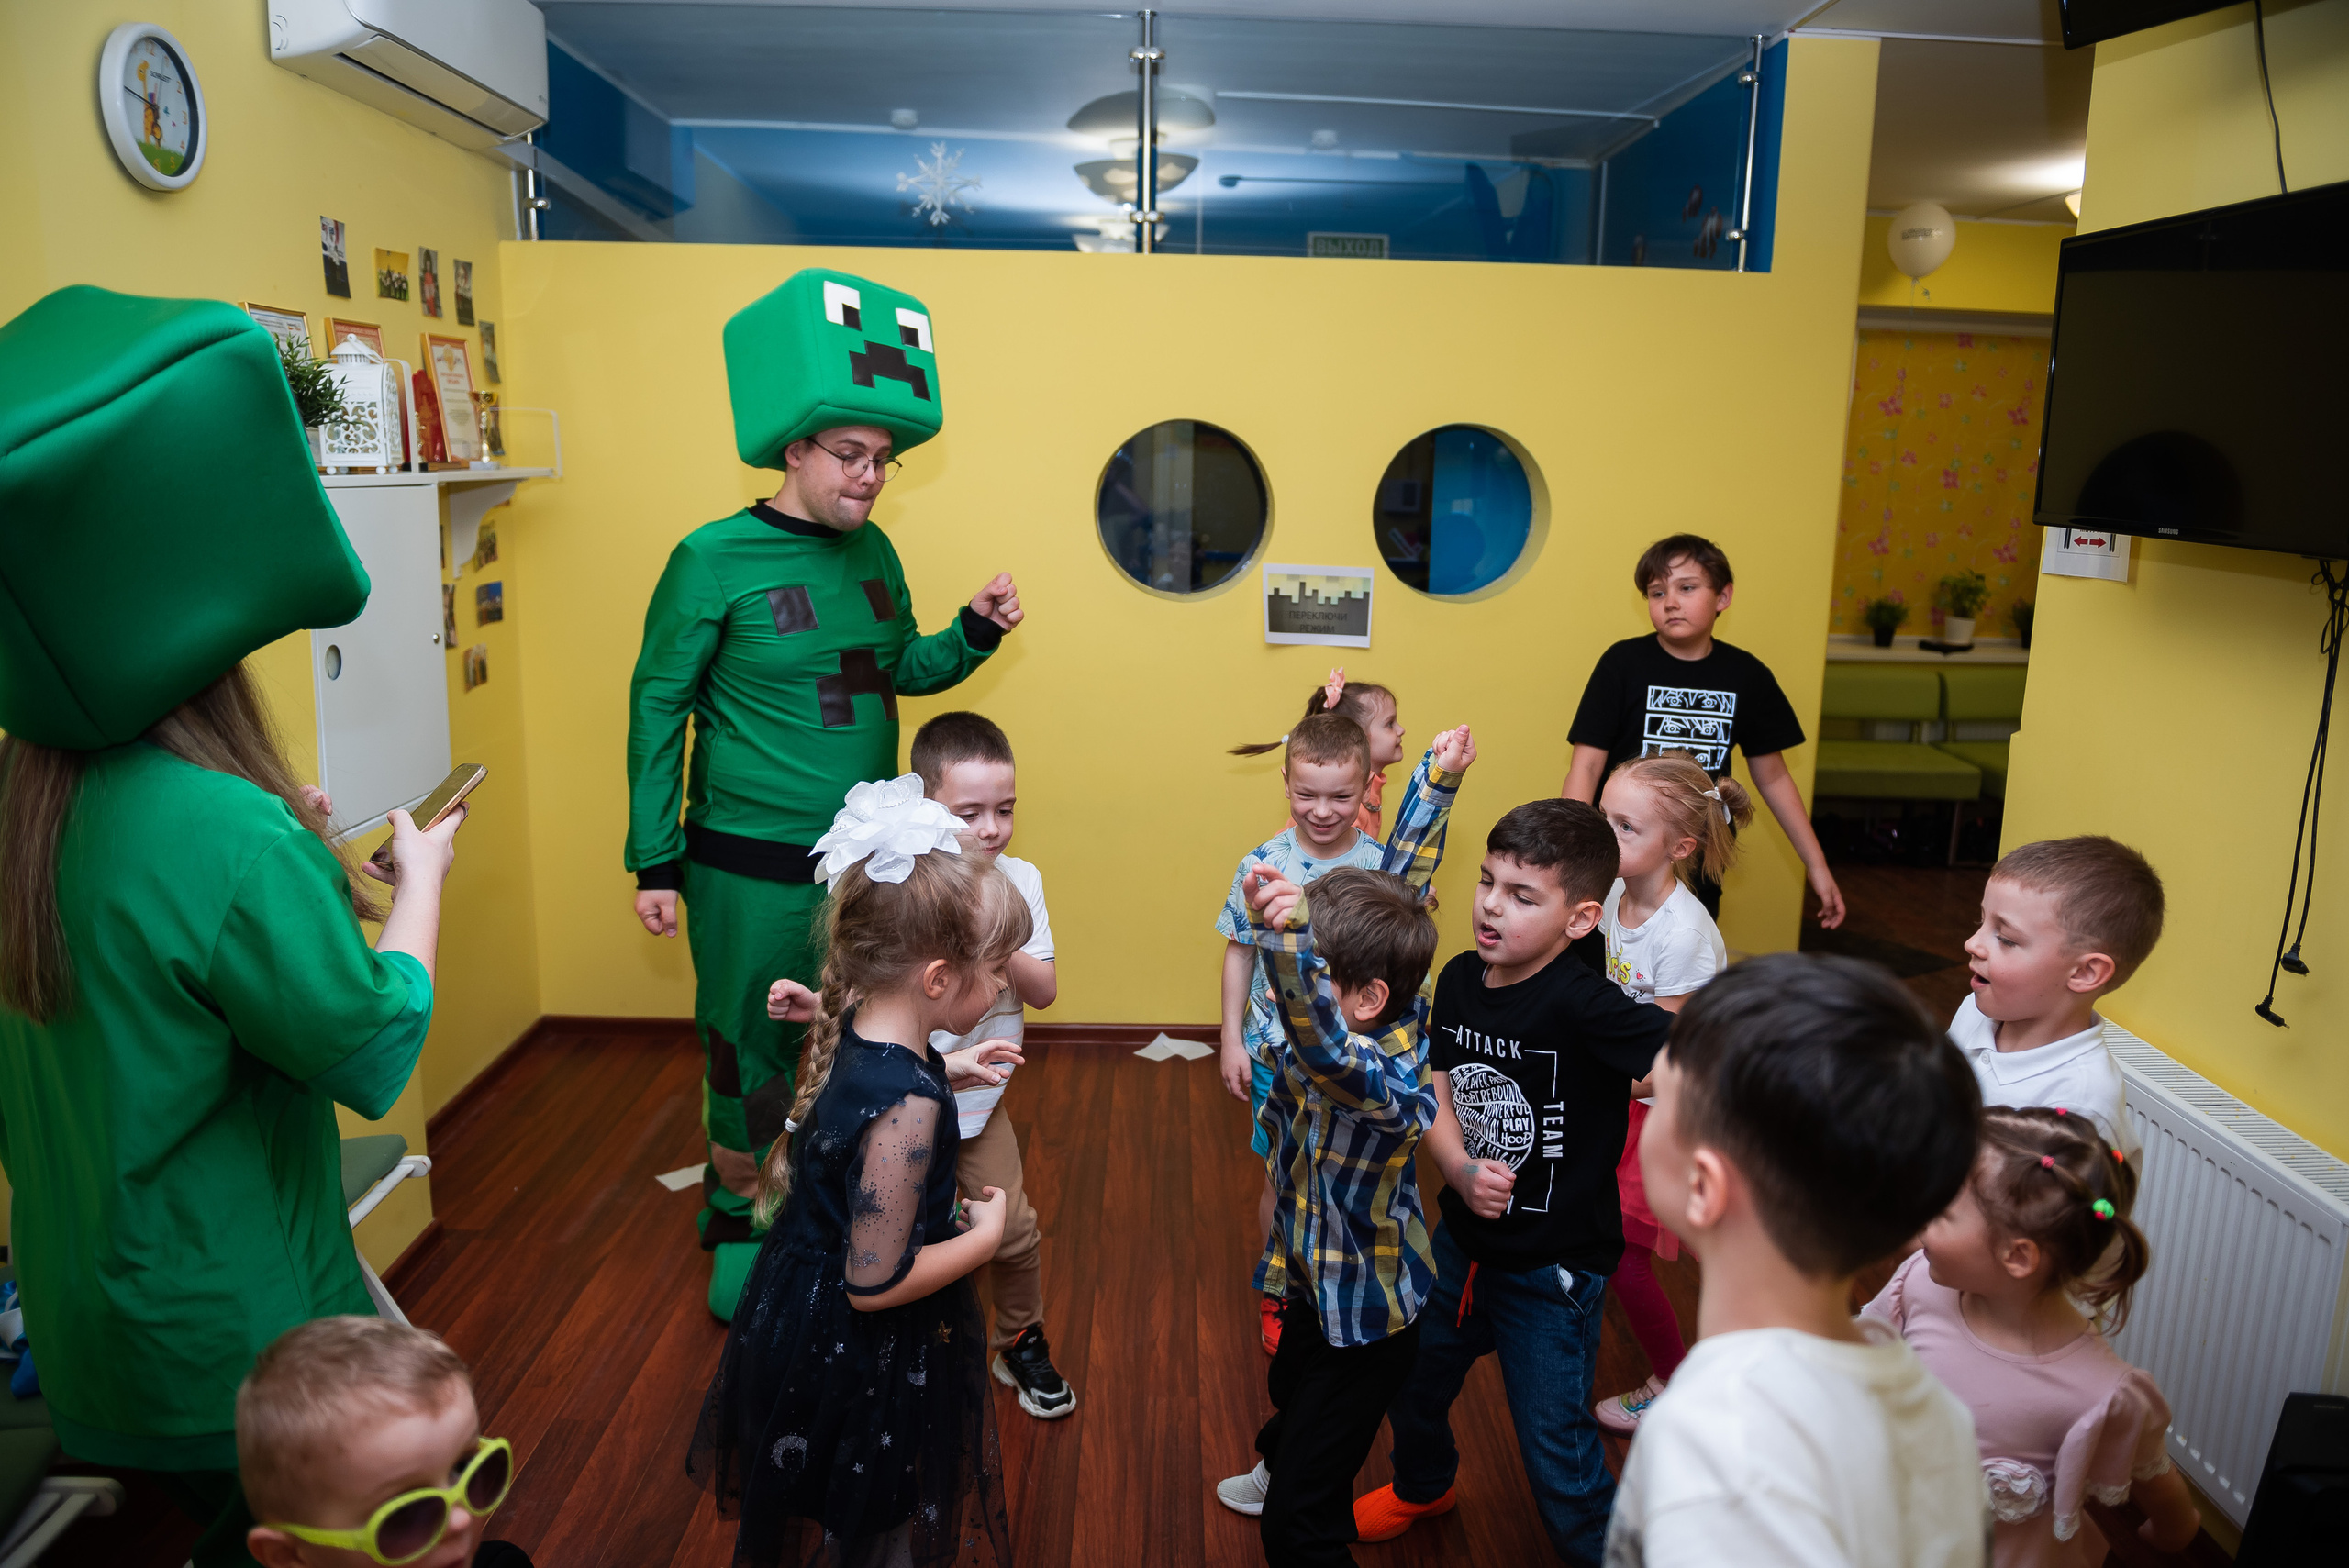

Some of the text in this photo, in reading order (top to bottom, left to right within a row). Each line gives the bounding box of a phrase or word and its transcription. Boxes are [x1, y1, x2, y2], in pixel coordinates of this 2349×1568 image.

[1316, 239, 1381, 258] ВЫХОД
[2158, 527, 2179, 535] SAMSUNG
[1288, 610, 1348, 621] ПЕРЕКЛЮЧИ
[1299, 624, 1335, 633] РЕЖИМ
[1456, 1025, 1522, 1060] ATTACK
[1455, 1090, 1479, 1103] SPORT
[1480, 1084, 1522, 1103] REBOUND
[1483, 1102, 1531, 1118] POWERFUL
[1502, 1118, 1530, 1132] PLAY
[1542, 1101, 1564, 1158] TEAM
[1501, 1132, 1531, 1147] HOOP
[1487, 1144, 1521, 1169] HIGH
